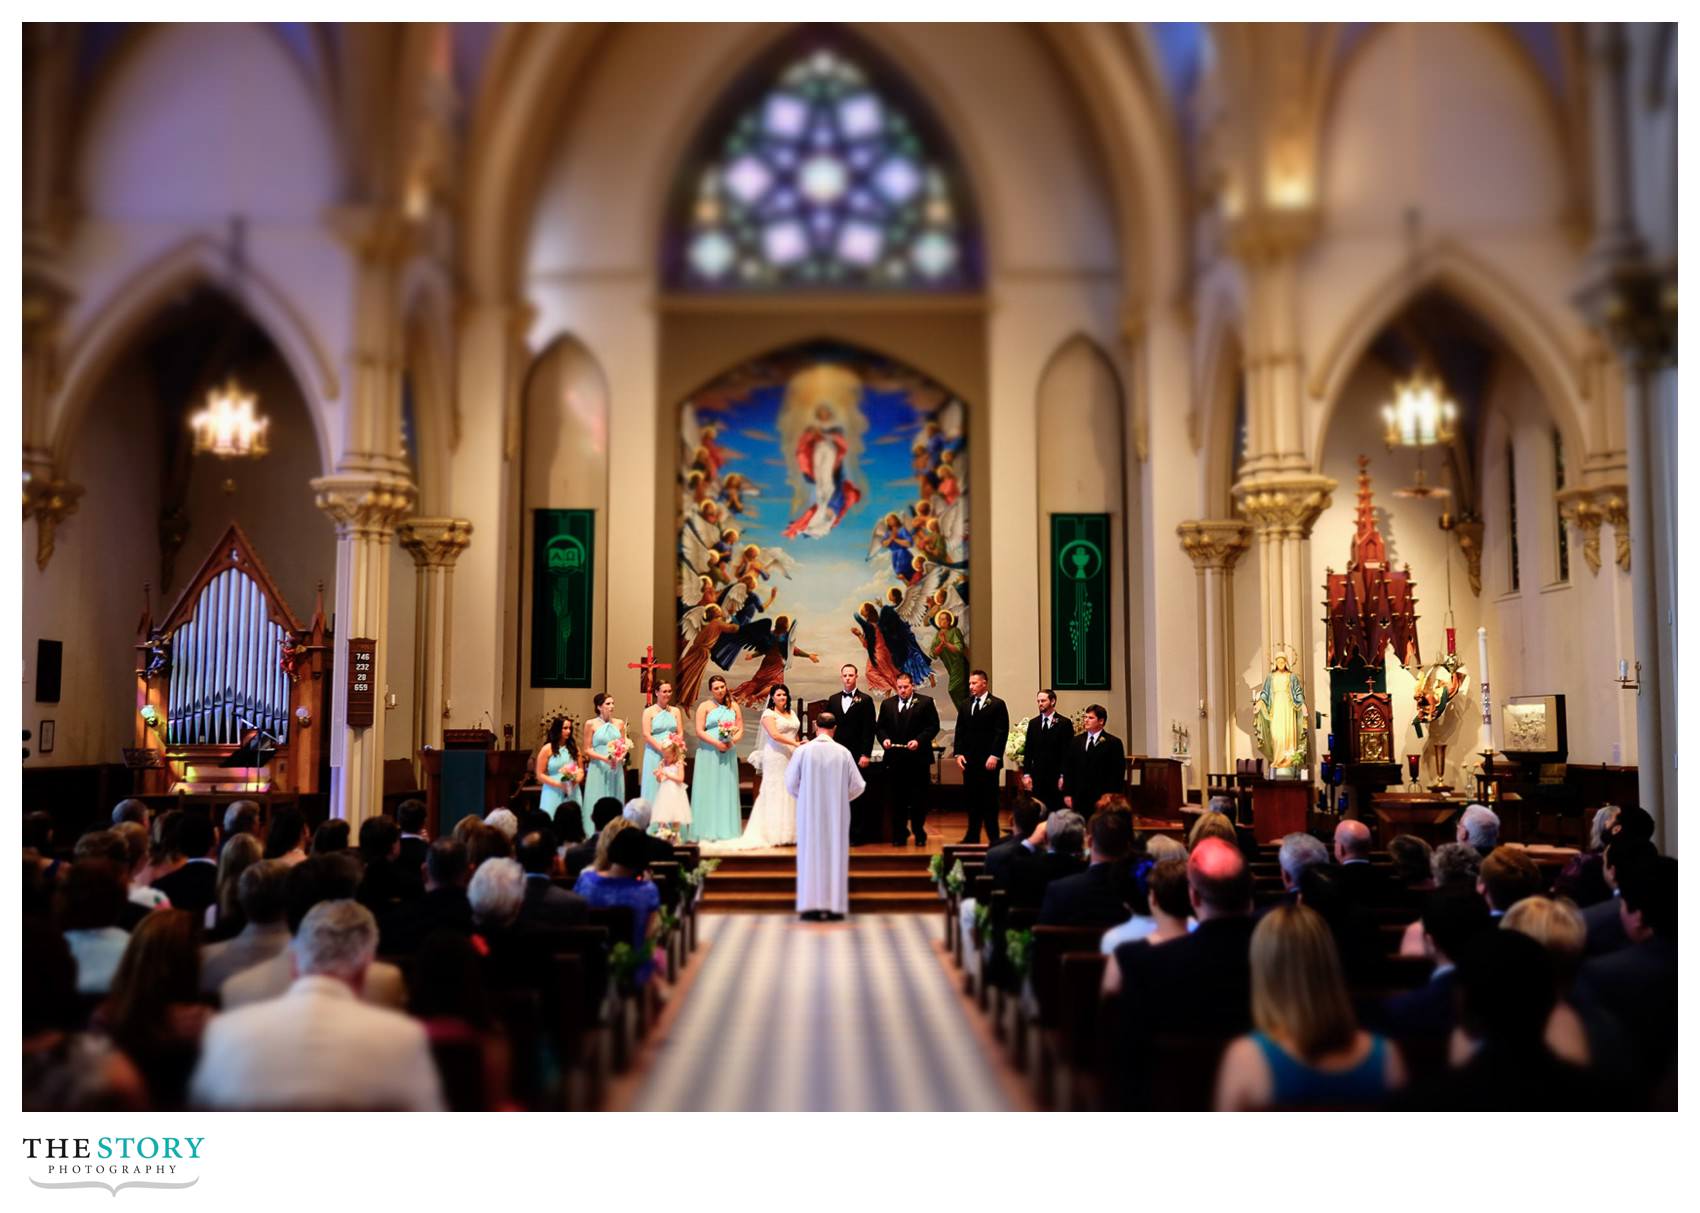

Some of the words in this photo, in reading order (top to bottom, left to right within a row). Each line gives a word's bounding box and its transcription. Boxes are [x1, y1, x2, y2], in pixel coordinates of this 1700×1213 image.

[356, 653, 370, 661] 746
[355, 663, 370, 671] 232
[354, 683, 368, 691] 659
